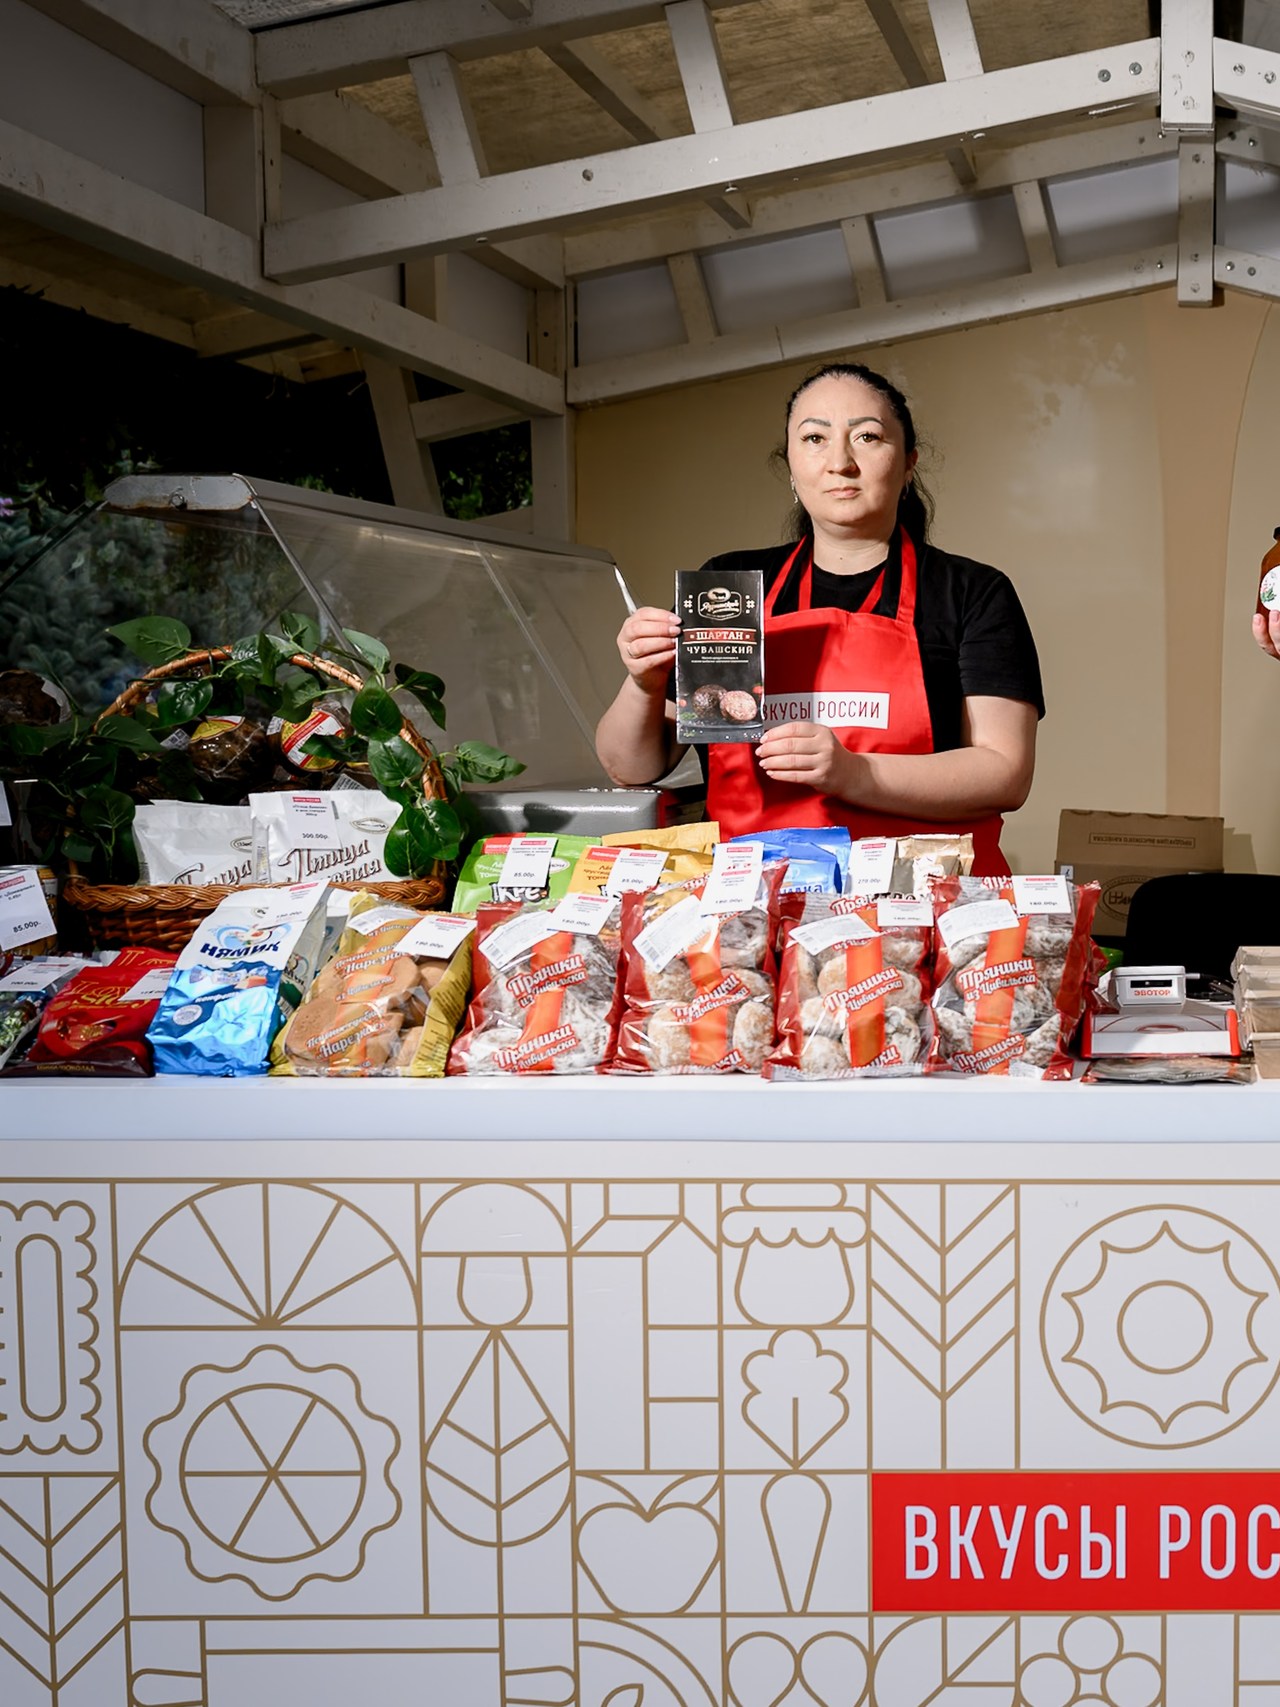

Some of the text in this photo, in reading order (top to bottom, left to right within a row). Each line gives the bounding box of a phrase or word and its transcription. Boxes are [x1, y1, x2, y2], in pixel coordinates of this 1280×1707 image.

[687, 646, 753, 654] ЧУВАШСКИЙ
[696, 632, 743, 640] ШАРТАН
[817, 701, 880, 718] РОССИИ
[13, 920, 42, 933] 85.00р.
[200, 940, 281, 960] НЯМИК
[507, 955, 583, 996] Пряники
[959, 958, 1034, 988] Пряники
[965, 971, 1037, 1001] из Цивильска
[519, 970, 587, 1008] из Цивильска
[673, 973, 742, 1017] Пряники
[824, 967, 899, 1011] Пряники
[847, 980, 903, 1011] Цивильска
[494, 1024, 574, 1067] Пряники
[518, 1037, 577, 1071] Цивильска
[954, 1035, 1022, 1069] Пряники
[975, 1046, 1024, 1070] Цивильска
[904, 1504, 1127, 1580] ВКУСЫ
